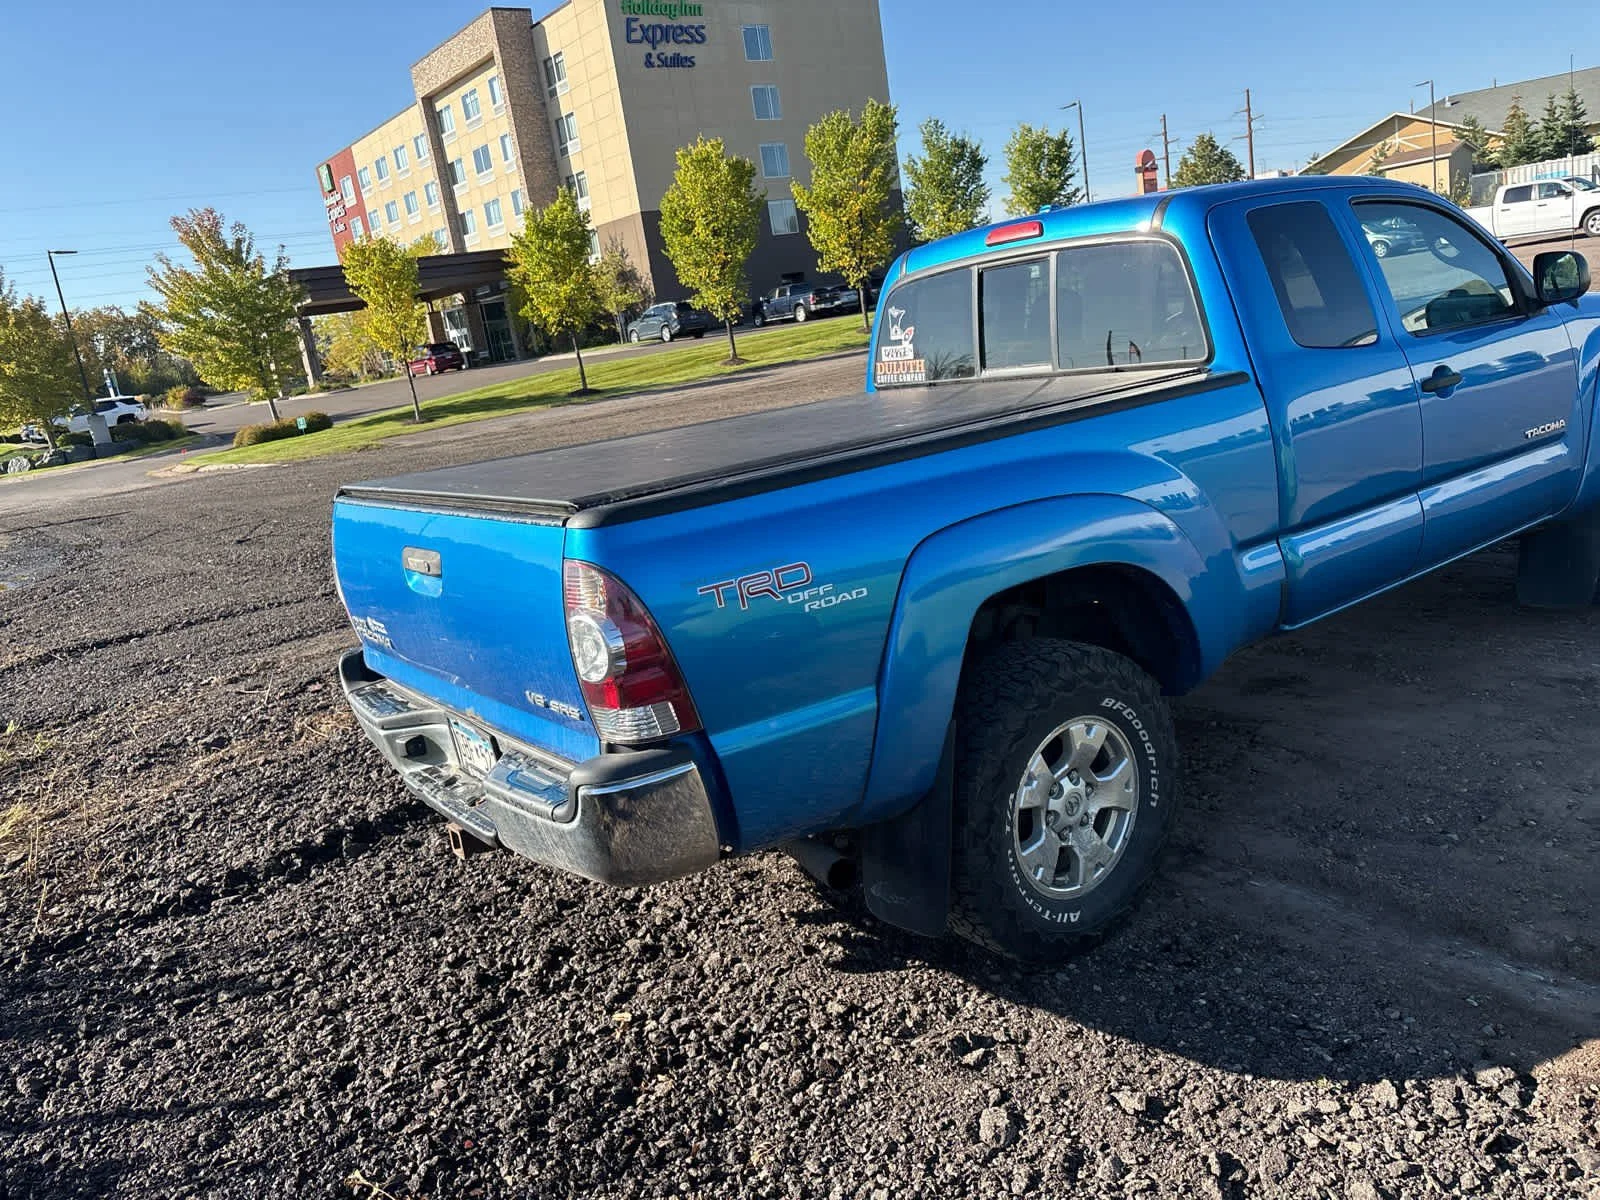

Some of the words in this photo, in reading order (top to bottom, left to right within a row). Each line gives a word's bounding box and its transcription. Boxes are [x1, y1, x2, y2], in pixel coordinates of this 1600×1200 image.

[621, 0, 679, 20] Holiday
[680, 0, 704, 16] Inn
[626, 17, 706, 50] Express
[644, 52, 655, 68] &
[657, 52, 696, 68] Suites
[876, 359, 926, 375] DULUTH
[1525, 419, 1566, 438] TACOMA
[697, 561, 813, 610] TRD
[787, 583, 833, 604] OFF
[804, 587, 868, 612] ROAD
[525, 690, 545, 708] V6
[1101, 697, 1160, 807] BFGoodrich
